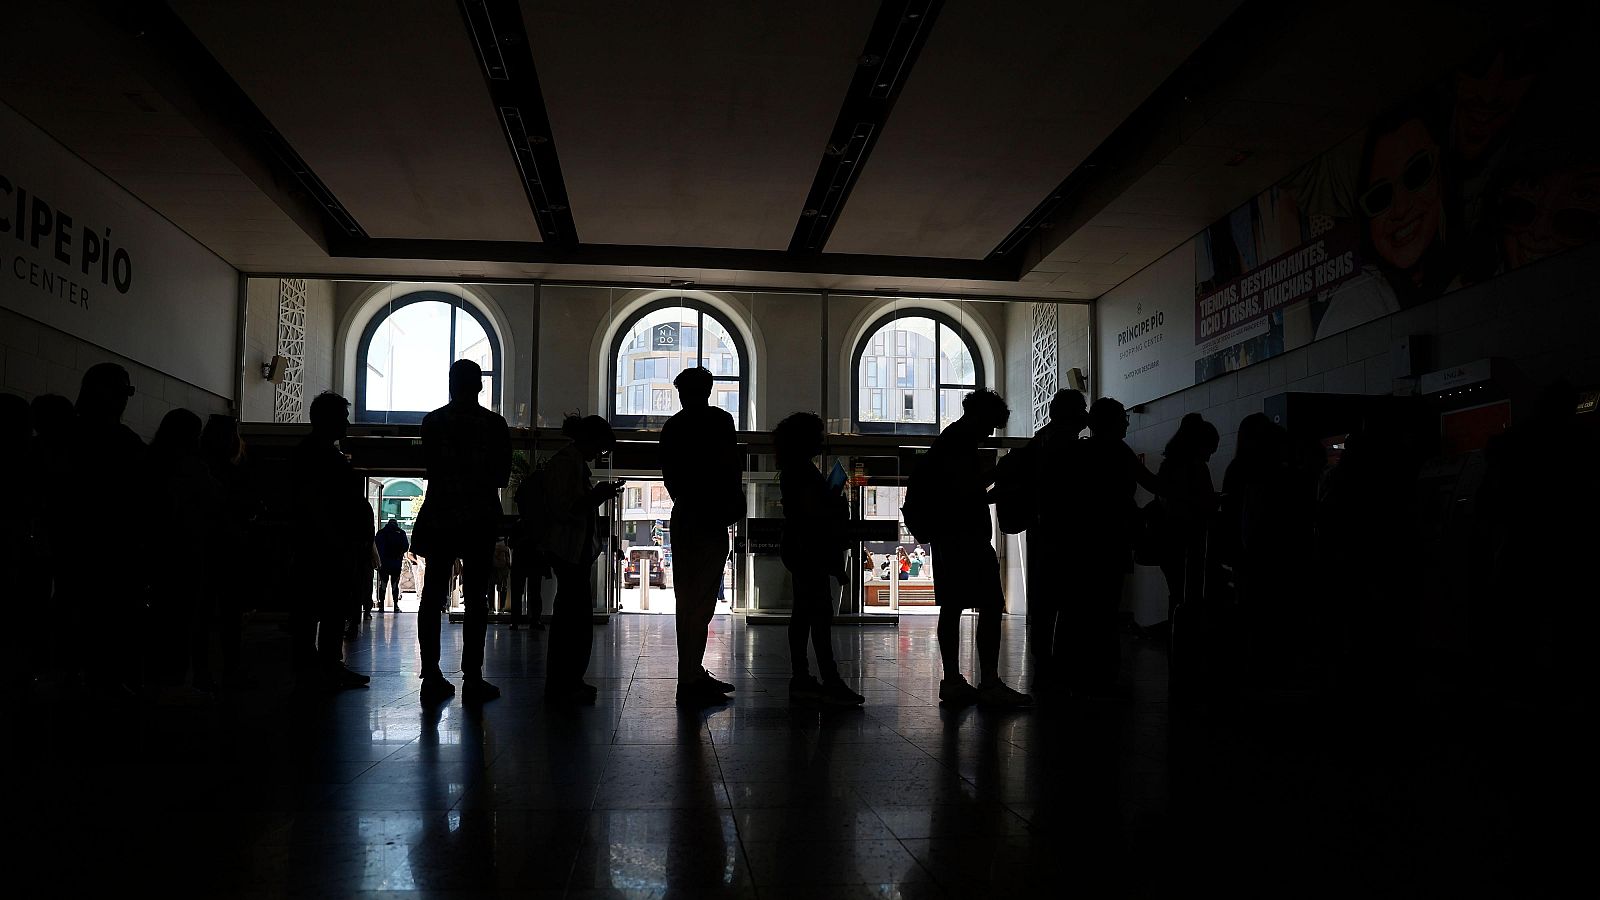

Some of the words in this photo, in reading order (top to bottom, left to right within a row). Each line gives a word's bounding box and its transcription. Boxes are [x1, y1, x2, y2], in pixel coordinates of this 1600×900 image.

[13, 256, 90, 310] CENTER
[82, 227, 132, 294] PÍO
[1199, 283, 1240, 319] TIENDAS,
[1240, 240, 1329, 298] RESTAURANTES,
[1200, 313, 1221, 338] OCIO
[1229, 295, 1262, 325] RISAS,
[1263, 269, 1313, 310] MUCHAS
[1315, 250, 1354, 289] RISAS
[1117, 318, 1149, 346] PRÍNCIPE
